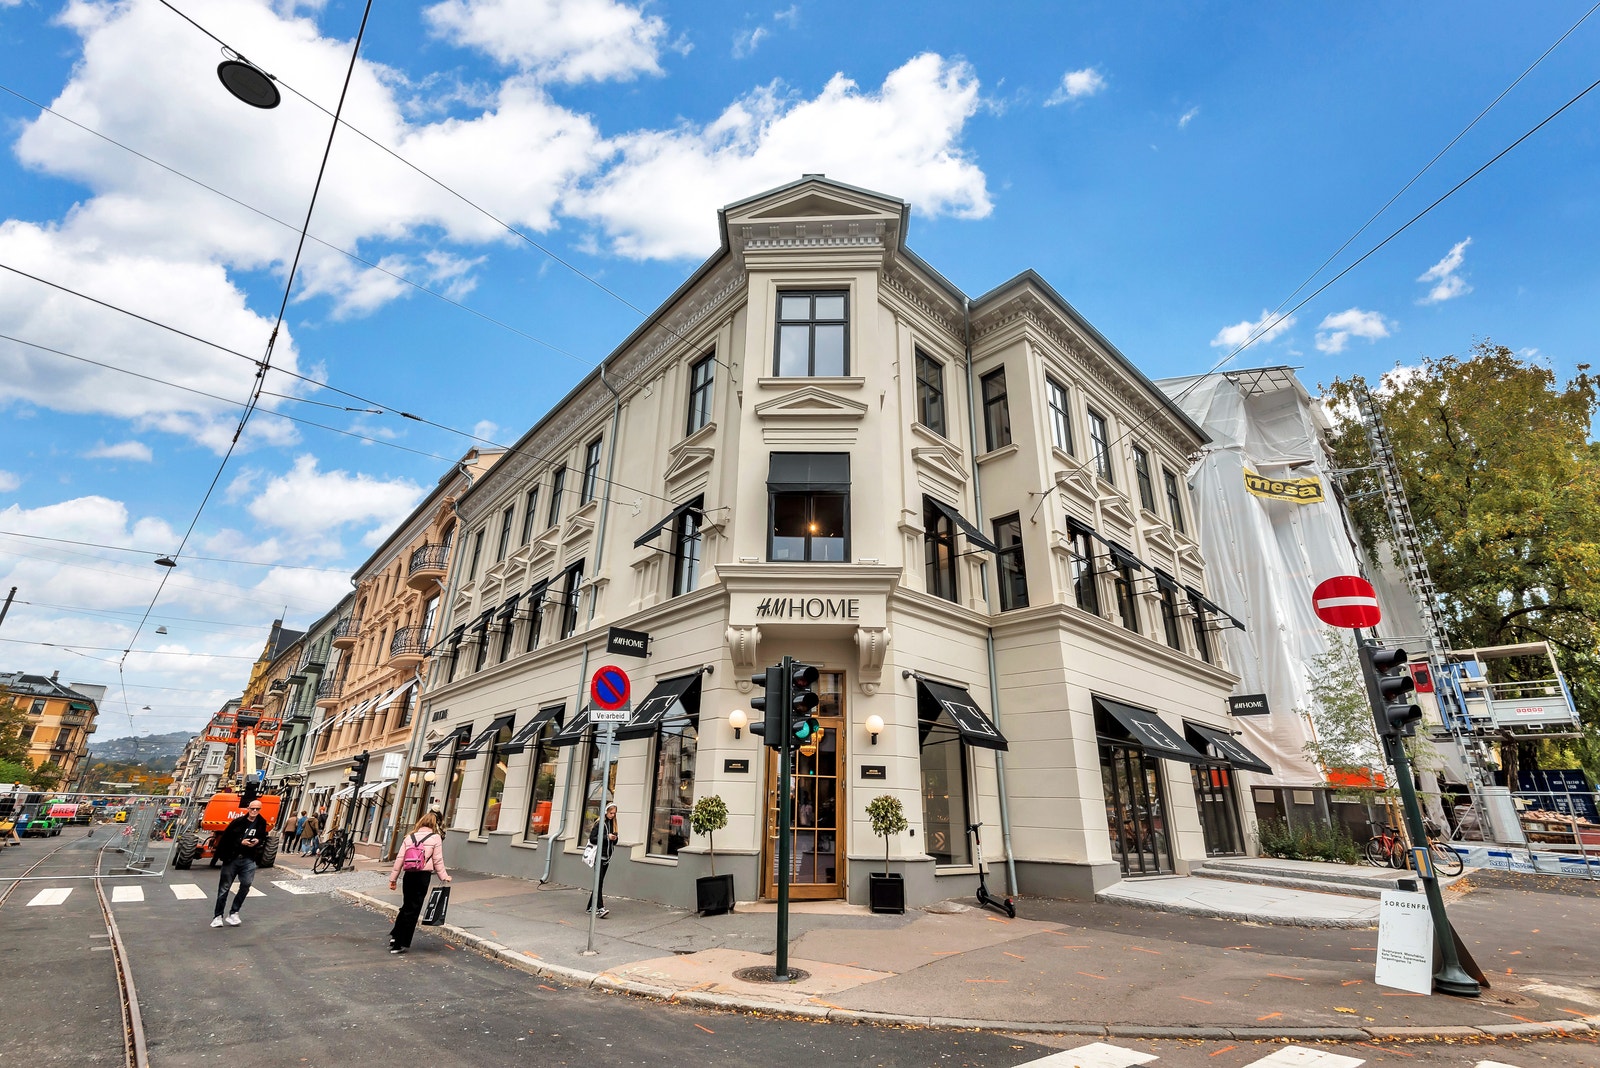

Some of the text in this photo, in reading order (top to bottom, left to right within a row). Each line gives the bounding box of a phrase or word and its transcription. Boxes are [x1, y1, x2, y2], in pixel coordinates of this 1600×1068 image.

[1246, 476, 1318, 497] mesa
[788, 597, 860, 619] HOME
[623, 638, 644, 649] HOME
[1243, 701, 1264, 709] HOME
[596, 712, 625, 720] Vearbeid
[1384, 900, 1430, 911] SORGENFRI
